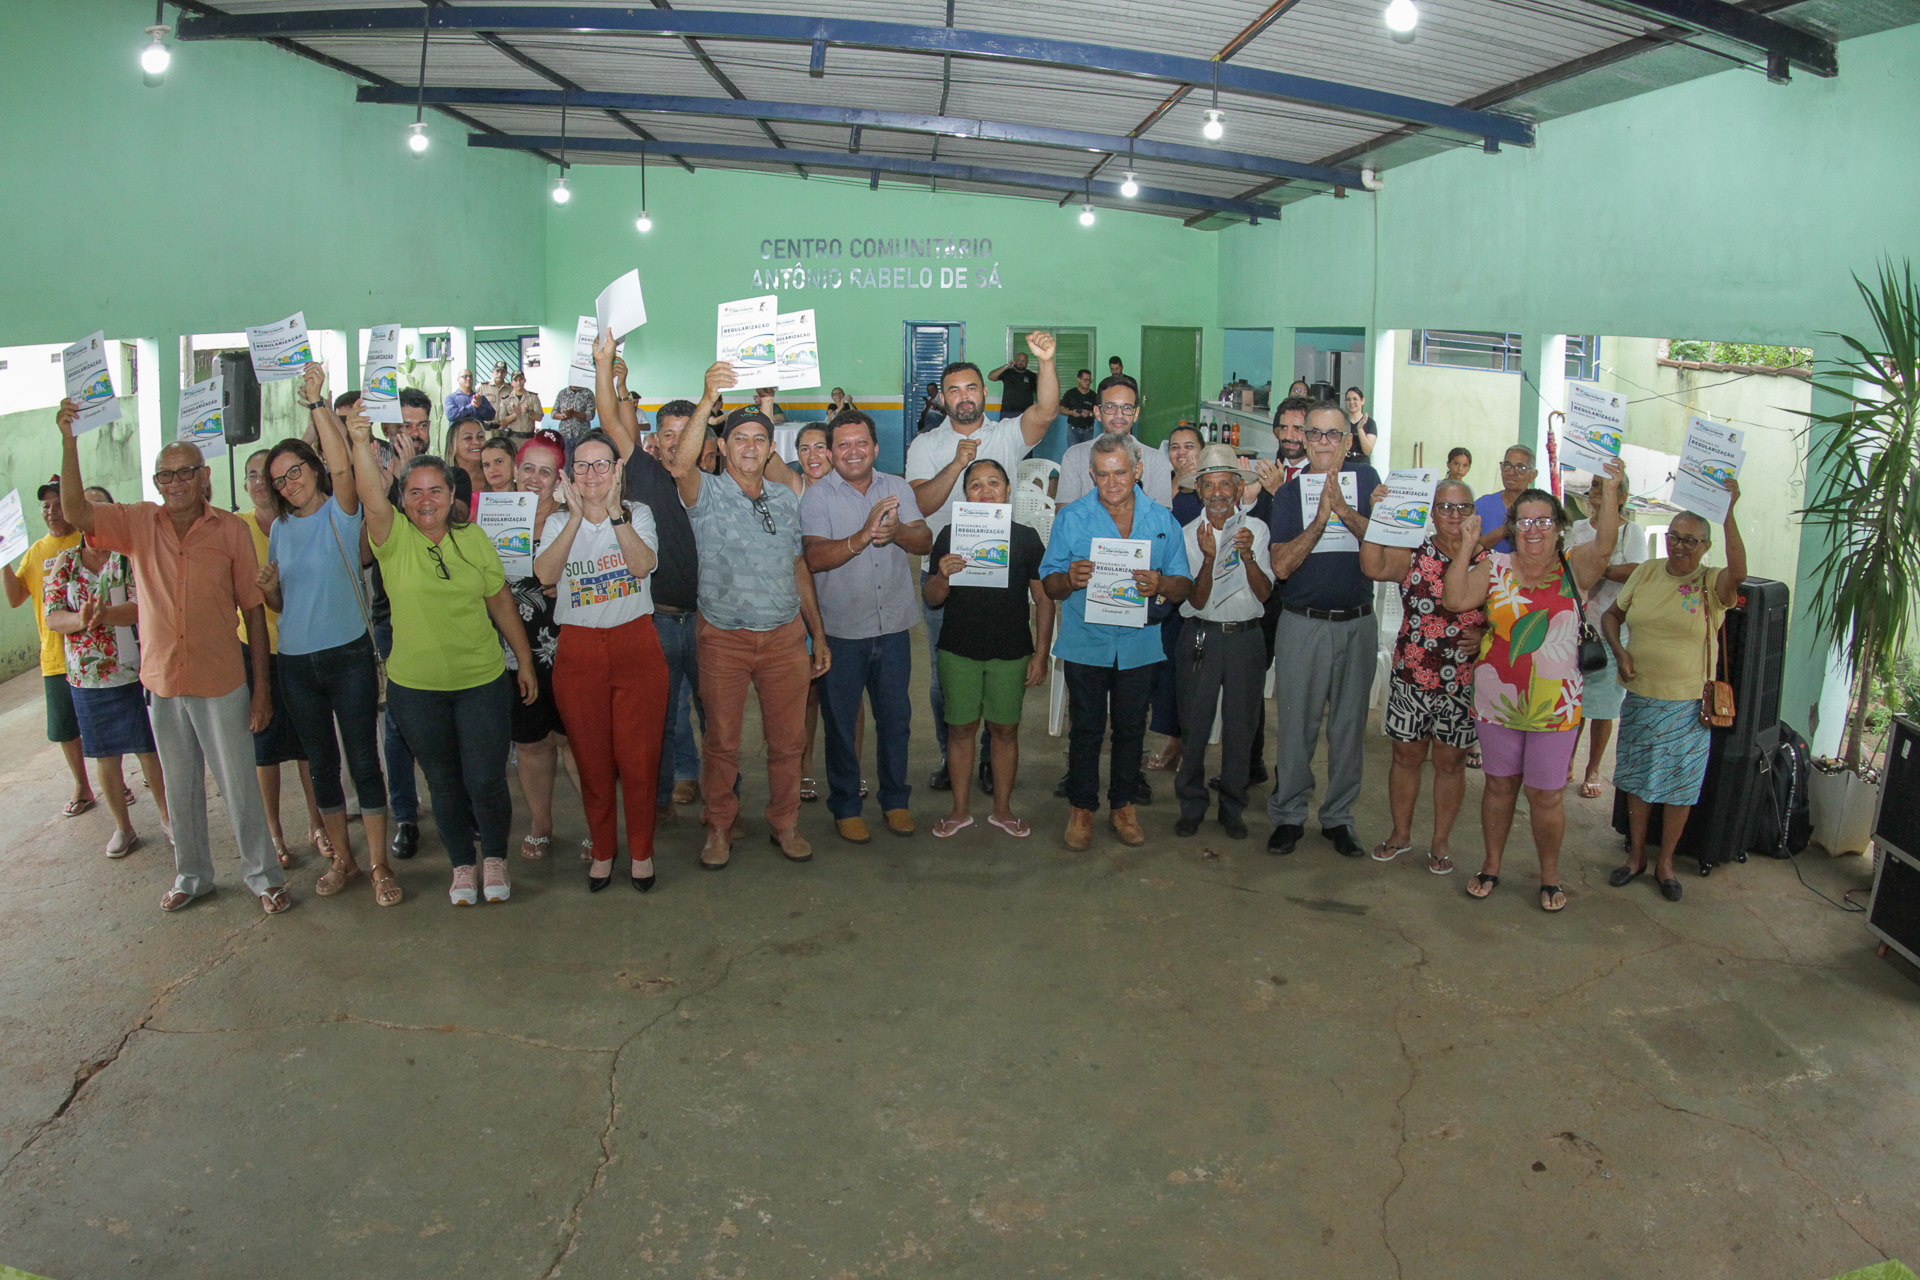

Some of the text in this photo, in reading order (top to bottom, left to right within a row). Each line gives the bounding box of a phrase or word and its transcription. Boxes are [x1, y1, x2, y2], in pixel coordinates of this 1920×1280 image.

[760, 232, 992, 260] CENTRO COMUNITÁRIO
[750, 261, 1002, 290] ANTÔNIO RABELO DE SÁ
[724, 323, 769, 333] REGULARIZAÇÃO
[256, 334, 302, 348] REGULARIZAÇÃO
[1574, 406, 1619, 423] REGULARIZAÇÃO
[1691, 440, 1734, 458] REGULARIZAÇÃO
[565, 553, 626, 577] SOLO SEGU
[584, 570, 627, 584] FAVELA
